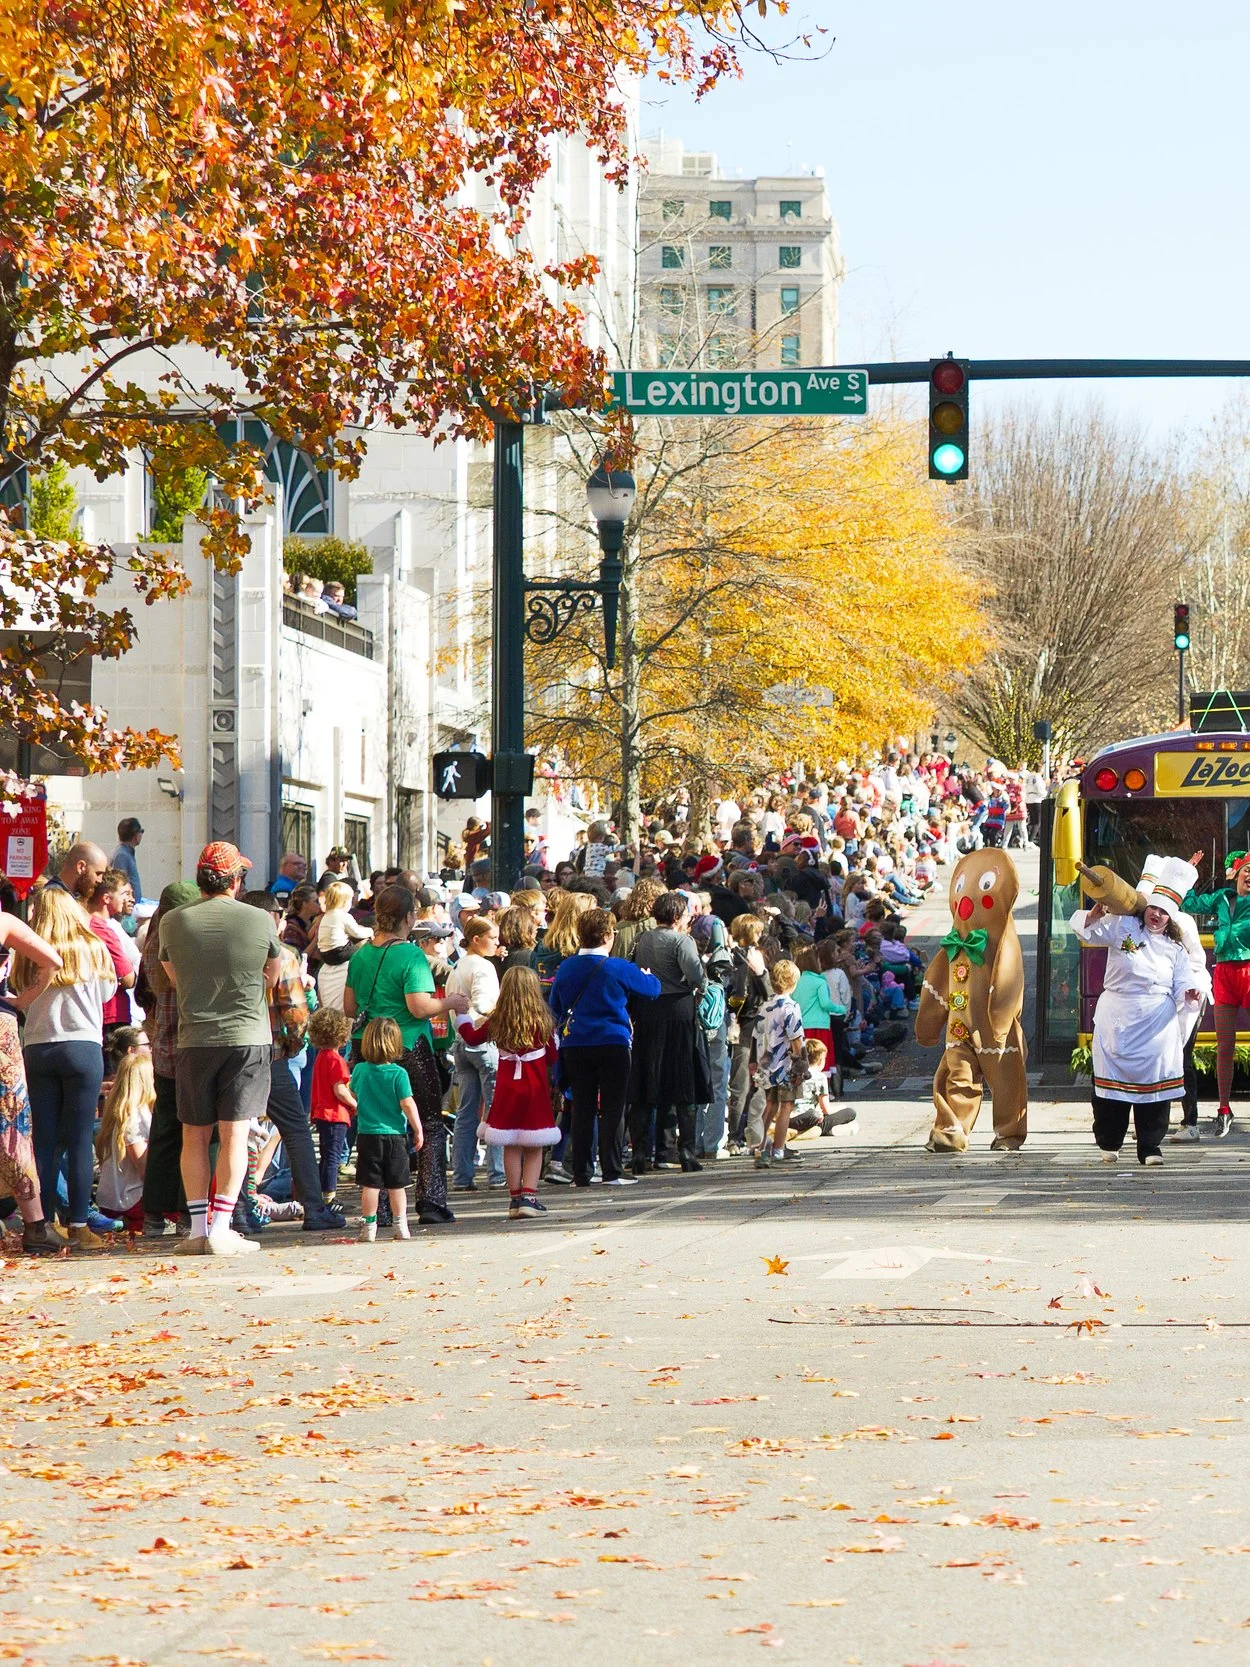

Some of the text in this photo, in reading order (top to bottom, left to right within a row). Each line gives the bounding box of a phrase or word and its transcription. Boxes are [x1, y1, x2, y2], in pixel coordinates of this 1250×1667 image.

[625, 373, 801, 414] Lexington
[806, 373, 841, 390] Ave
[847, 373, 860, 390] S
